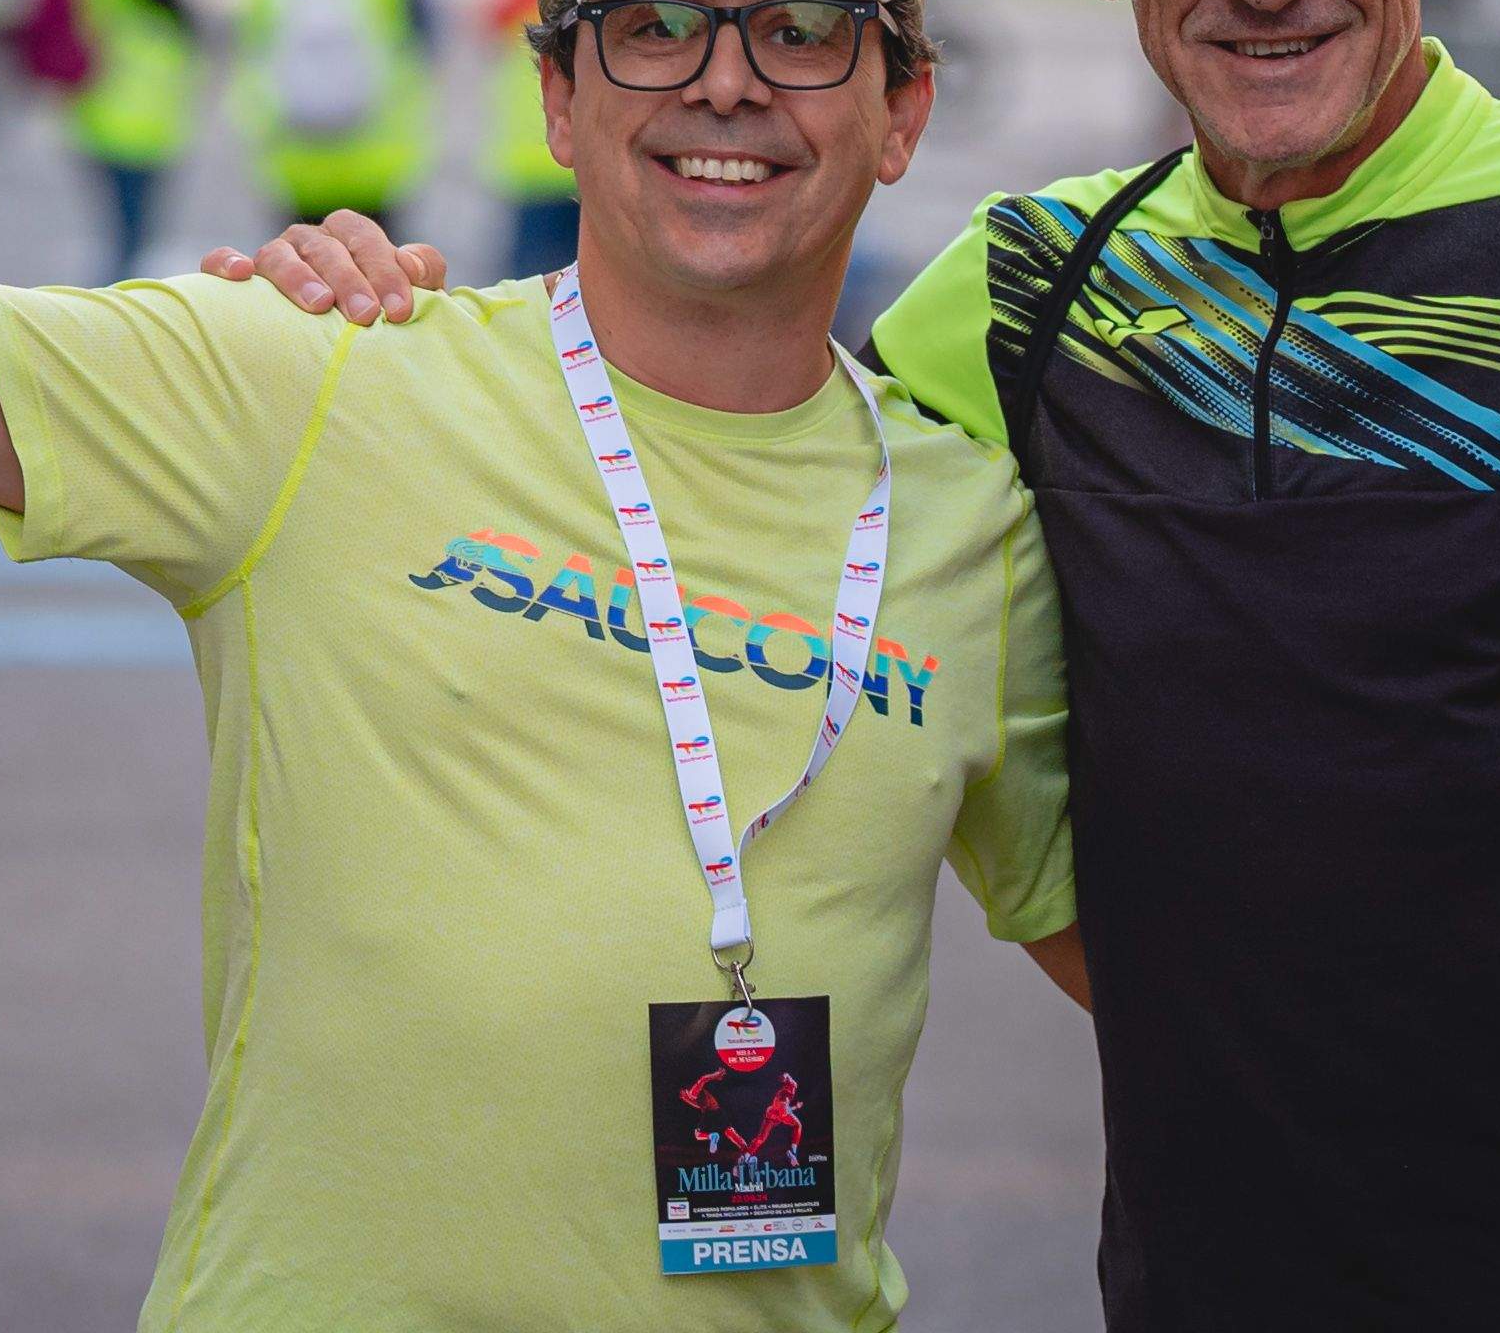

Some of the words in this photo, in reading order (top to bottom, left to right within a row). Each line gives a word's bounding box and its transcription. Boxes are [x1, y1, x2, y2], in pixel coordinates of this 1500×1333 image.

[678, 1163, 733, 1193] Milla
[738, 1161, 816, 1190] Urbana
[734, 1182, 764, 1193] Madrid
[693, 1237, 808, 1266] PRENSA
